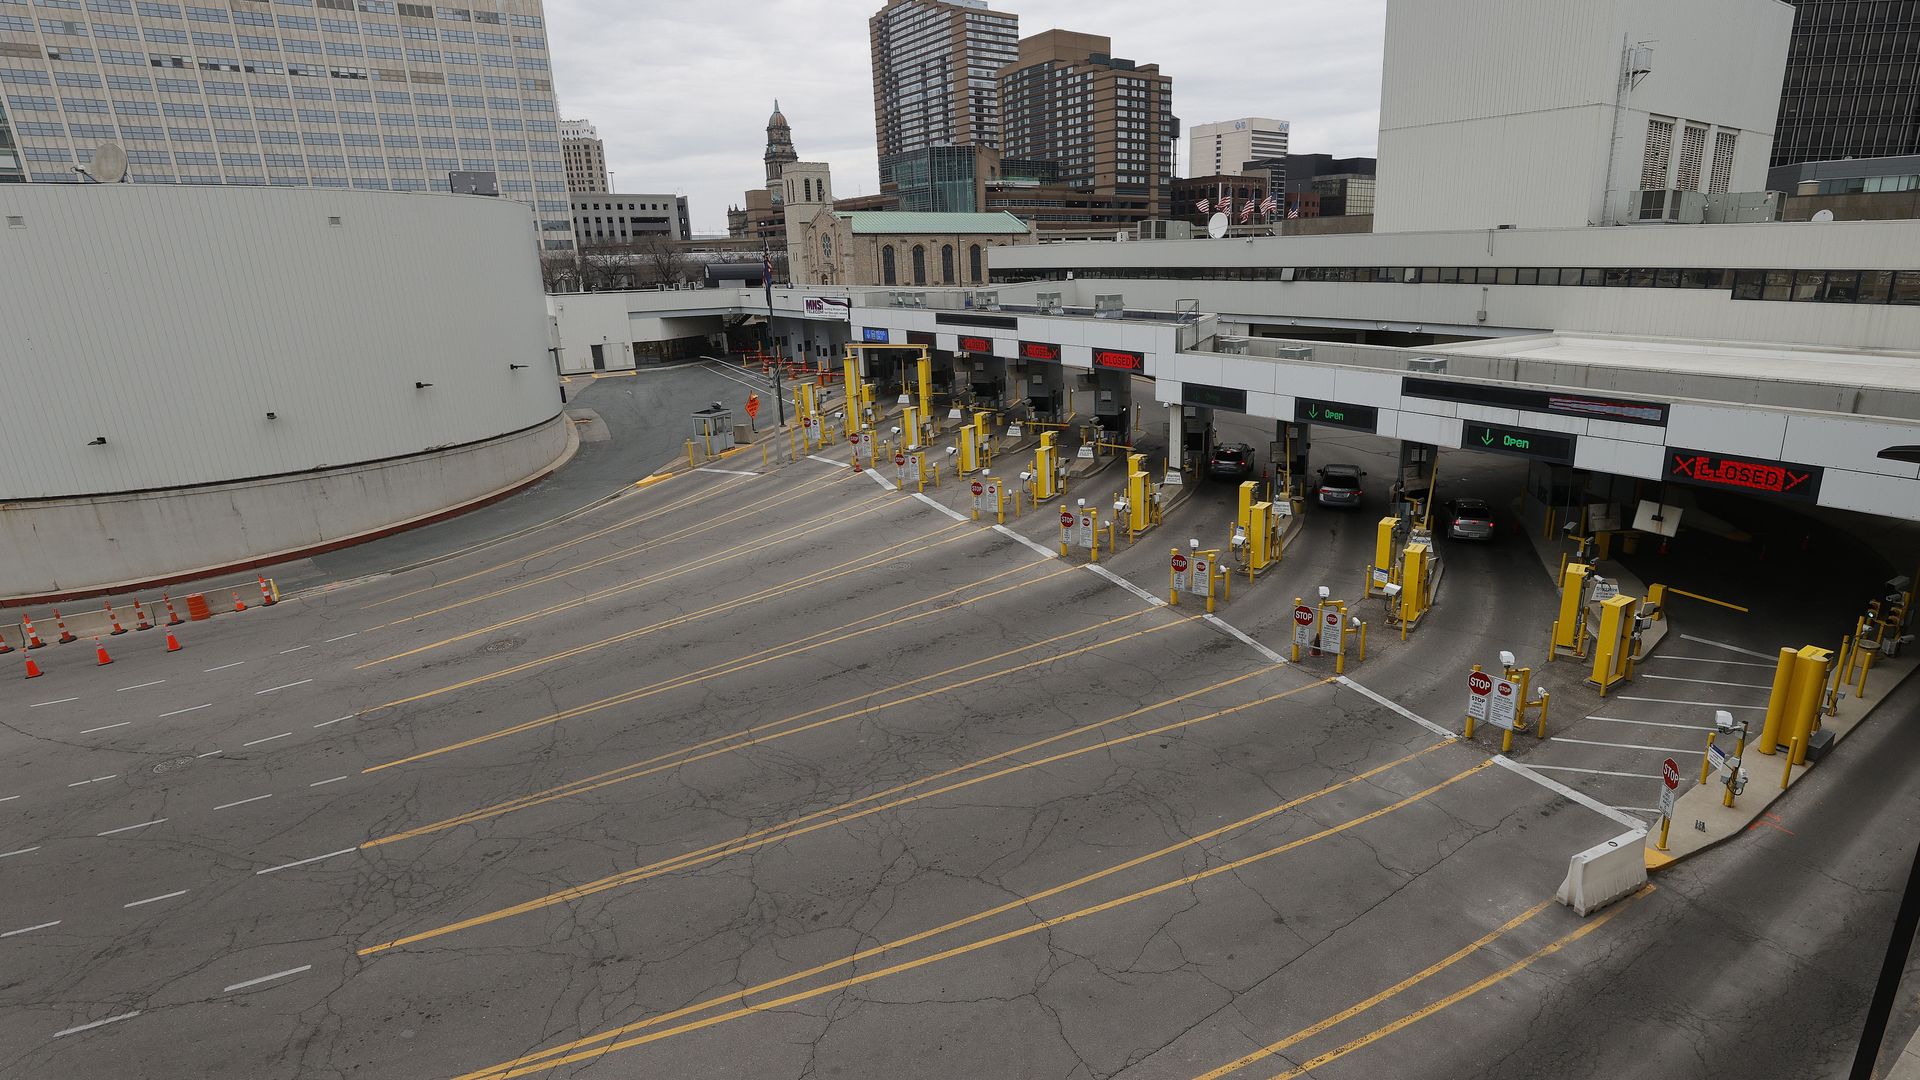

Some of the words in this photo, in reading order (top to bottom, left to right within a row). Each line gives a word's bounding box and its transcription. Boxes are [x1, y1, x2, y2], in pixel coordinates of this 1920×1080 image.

[1104, 353, 1131, 366] CLOSED
[1324, 409, 1344, 421] Open
[1503, 435, 1530, 449] Open
[1172, 559, 1187, 568] STOP
[1295, 610, 1313, 621] STOP
[1469, 677, 1491, 691] STOP
[1471, 695, 1486, 703] STOP
[1663, 763, 1679, 784] STOP
